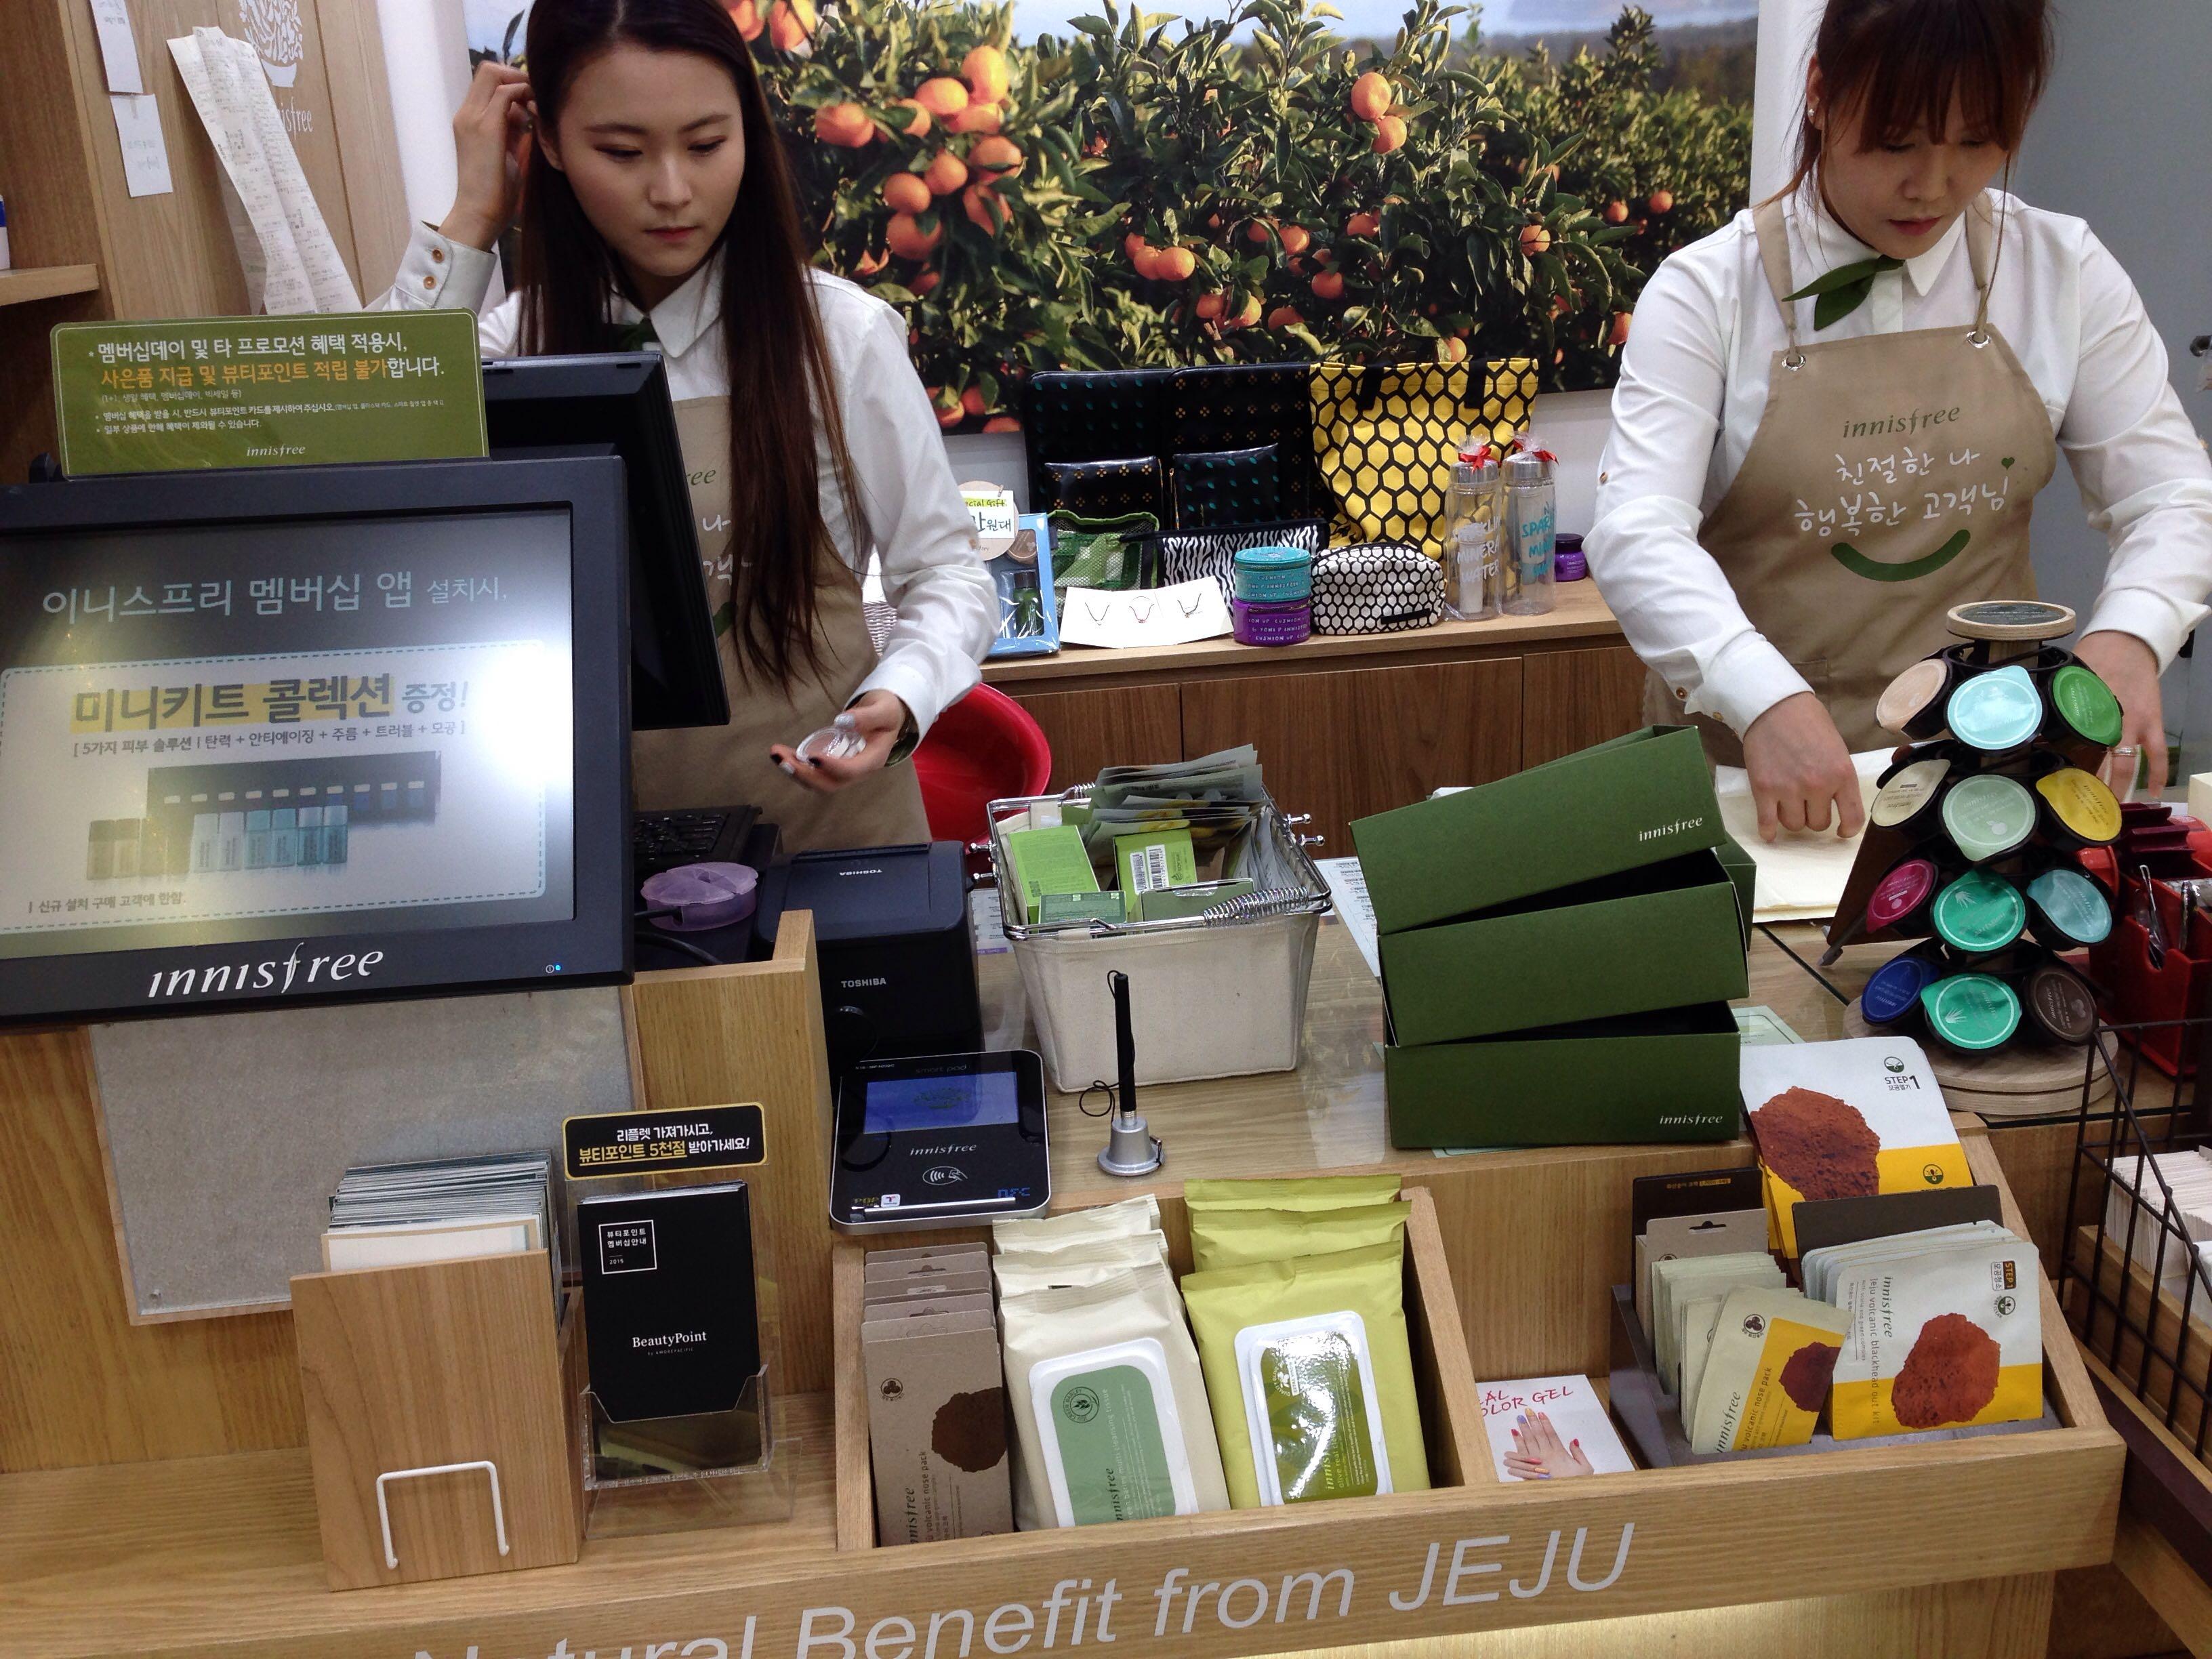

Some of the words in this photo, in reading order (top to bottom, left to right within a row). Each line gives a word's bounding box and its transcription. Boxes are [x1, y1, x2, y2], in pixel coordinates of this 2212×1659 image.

[279, 96, 314, 140] isfree
[98, 340, 186, 364] 멤버십데이
[190, 338, 209, 360] 및
[213, 337, 232, 359] 타
[237, 335, 306, 356] 프로모션
[310, 333, 346, 355] 혜택
[350, 331, 407, 354] 적용시,
[101, 367, 154, 390] 사은품
[159, 365, 194, 387] 지급
[199, 364, 217, 386] 및
[222, 362, 310, 386] 뷰티포인트
[313, 359, 348, 382] 적립
[353, 356, 446, 380] 불가합니다.
[103, 411, 127, 422] 멤버십
[128, 410, 152, 420] 혜택을
[184, 408, 207, 418] 반드시
[209, 406, 248, 416] 뷰티포인트
[218, 420, 227, 429] 수
[1842, 406, 1961, 438] innisfree
[246, 443, 307, 458] innisfree
[1835, 447, 1935, 485] 친절한
[1949, 447, 1981, 466] 나
[1794, 491, 1907, 537] 행복한
[1923, 476, 2009, 520] 고객님
[702, 514, 731, 532] 나
[41, 579, 233, 624] 이니스프리
[249, 573, 363, 616] 멤버십
[377, 571, 413, 609] 앱
[426, 576, 508, 604] 설치시,
[75, 682, 250, 733] 미니키트
[262, 674, 394, 723] 콜렉션
[401, 679, 470, 714] 증정!
[121, 738, 149, 754] 피부
[152, 736, 192, 753] 솔루션
[205, 733, 232, 750] 탄력
[249, 729, 314, 747] 안티에이징
[331, 726, 359, 742] 주름
[375, 722, 413, 739] 트러블
[431, 720, 458, 736] 모공
[1638, 815, 1704, 842] innisfree
[839, 868, 883, 876] TOSHIBA
[39, 899, 62, 913] 신규
[66, 897, 89, 912] 설치
[92, 896, 116, 909] 구매
[119, 893, 155, 907] 고객에
[147, 943, 384, 998] innisfree
[840, 977, 887, 989] TOSHIBA
[1884, 1076, 1909, 1084] STEP
[1908, 1075, 1921, 1090] 1
[617, 1127, 651, 1142] 리플렛
[653, 1122, 714, 1140] 가져가시고,
[1659, 1113, 1724, 1127] innisfree
[579, 1143, 647, 1163] 뷰티포인트
[649, 1140, 686, 1158] 5천점
[688, 1136, 750, 1154] 받아가세요!
[909, 1143, 977, 1158] innisfree
[607, 1228, 647, 1238] 뷰티포인트
[607, 1237, 647, 1248] 멤버십안내
[1869, 1277, 1879, 1294] jeju
[2004, 1261, 2015, 1283] STEP
[1868, 1297, 1878, 1338] volcanic
[1880, 1275, 1894, 1338] innisfree
[632, 1330, 707, 1348] BeautyPoint
[1870, 1340, 1881, 1389] blackhead
[1480, 1390, 1509, 1406] AL
[1481, 1397, 1528, 1417] OLOR
[1532, 1385, 1574, 1405] GEL
[1715, 1391, 1741, 1454] innisfree
[1745, 1408, 1759, 1444] volcanic
[1755, 1385, 1765, 1408] nose
[918, 1451, 930, 1471] pack
[1323, 1451, 1335, 1490] innis
[922, 1473, 930, 1494] nose
[1105, 1468, 1124, 1521] nnisfree
[905, 1487, 920, 1544] nnisfree
[922, 1496, 933, 1533] volcanic
[798, 1576, 1124, 1659] Benefit
[1153, 1565, 1355, 1637] from
[1389, 1522, 1635, 1612] JEJU
